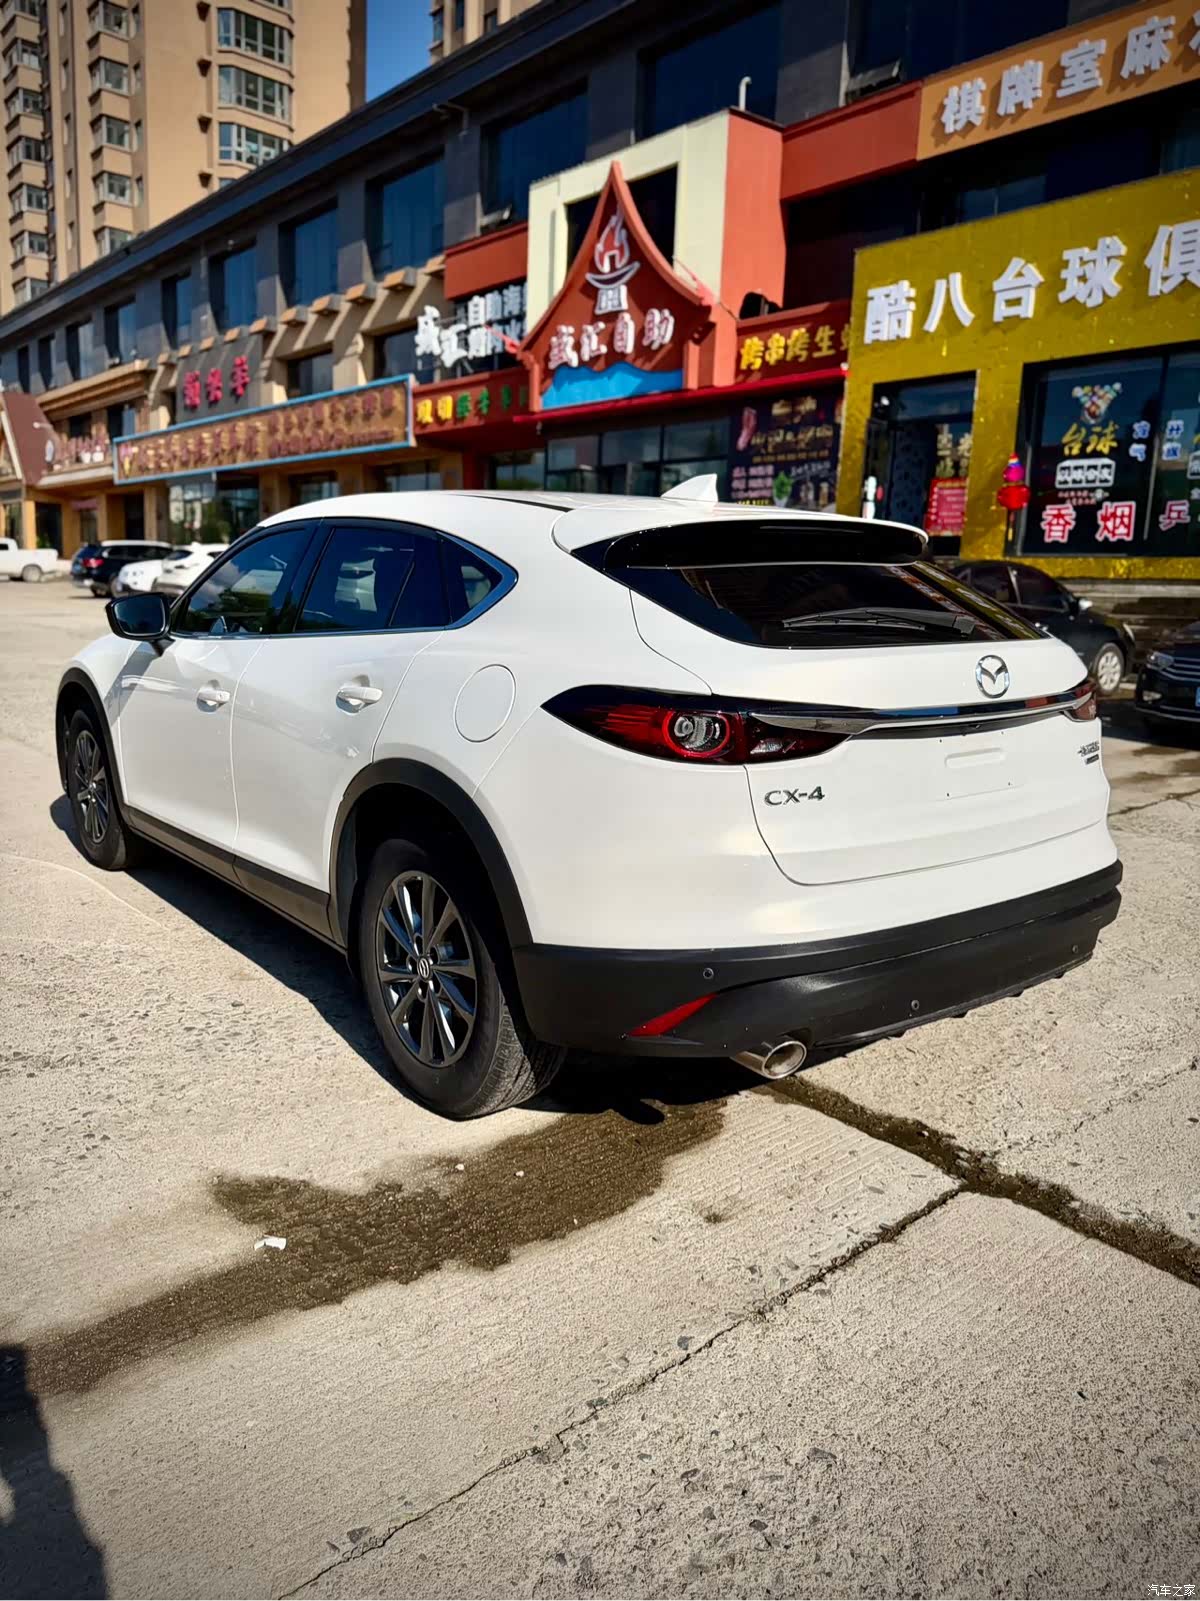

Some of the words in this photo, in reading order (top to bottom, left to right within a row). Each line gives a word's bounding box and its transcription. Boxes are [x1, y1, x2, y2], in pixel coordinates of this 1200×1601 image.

[941, 10, 1200, 134] 棋牌室麻
[863, 219, 1200, 344] 酷八台球俱
[548, 308, 675, 370] 盛汇自助
[1061, 421, 1119, 456] 台球
[1041, 501, 1136, 542] 香烟
[764, 785, 826, 807] CX-4
